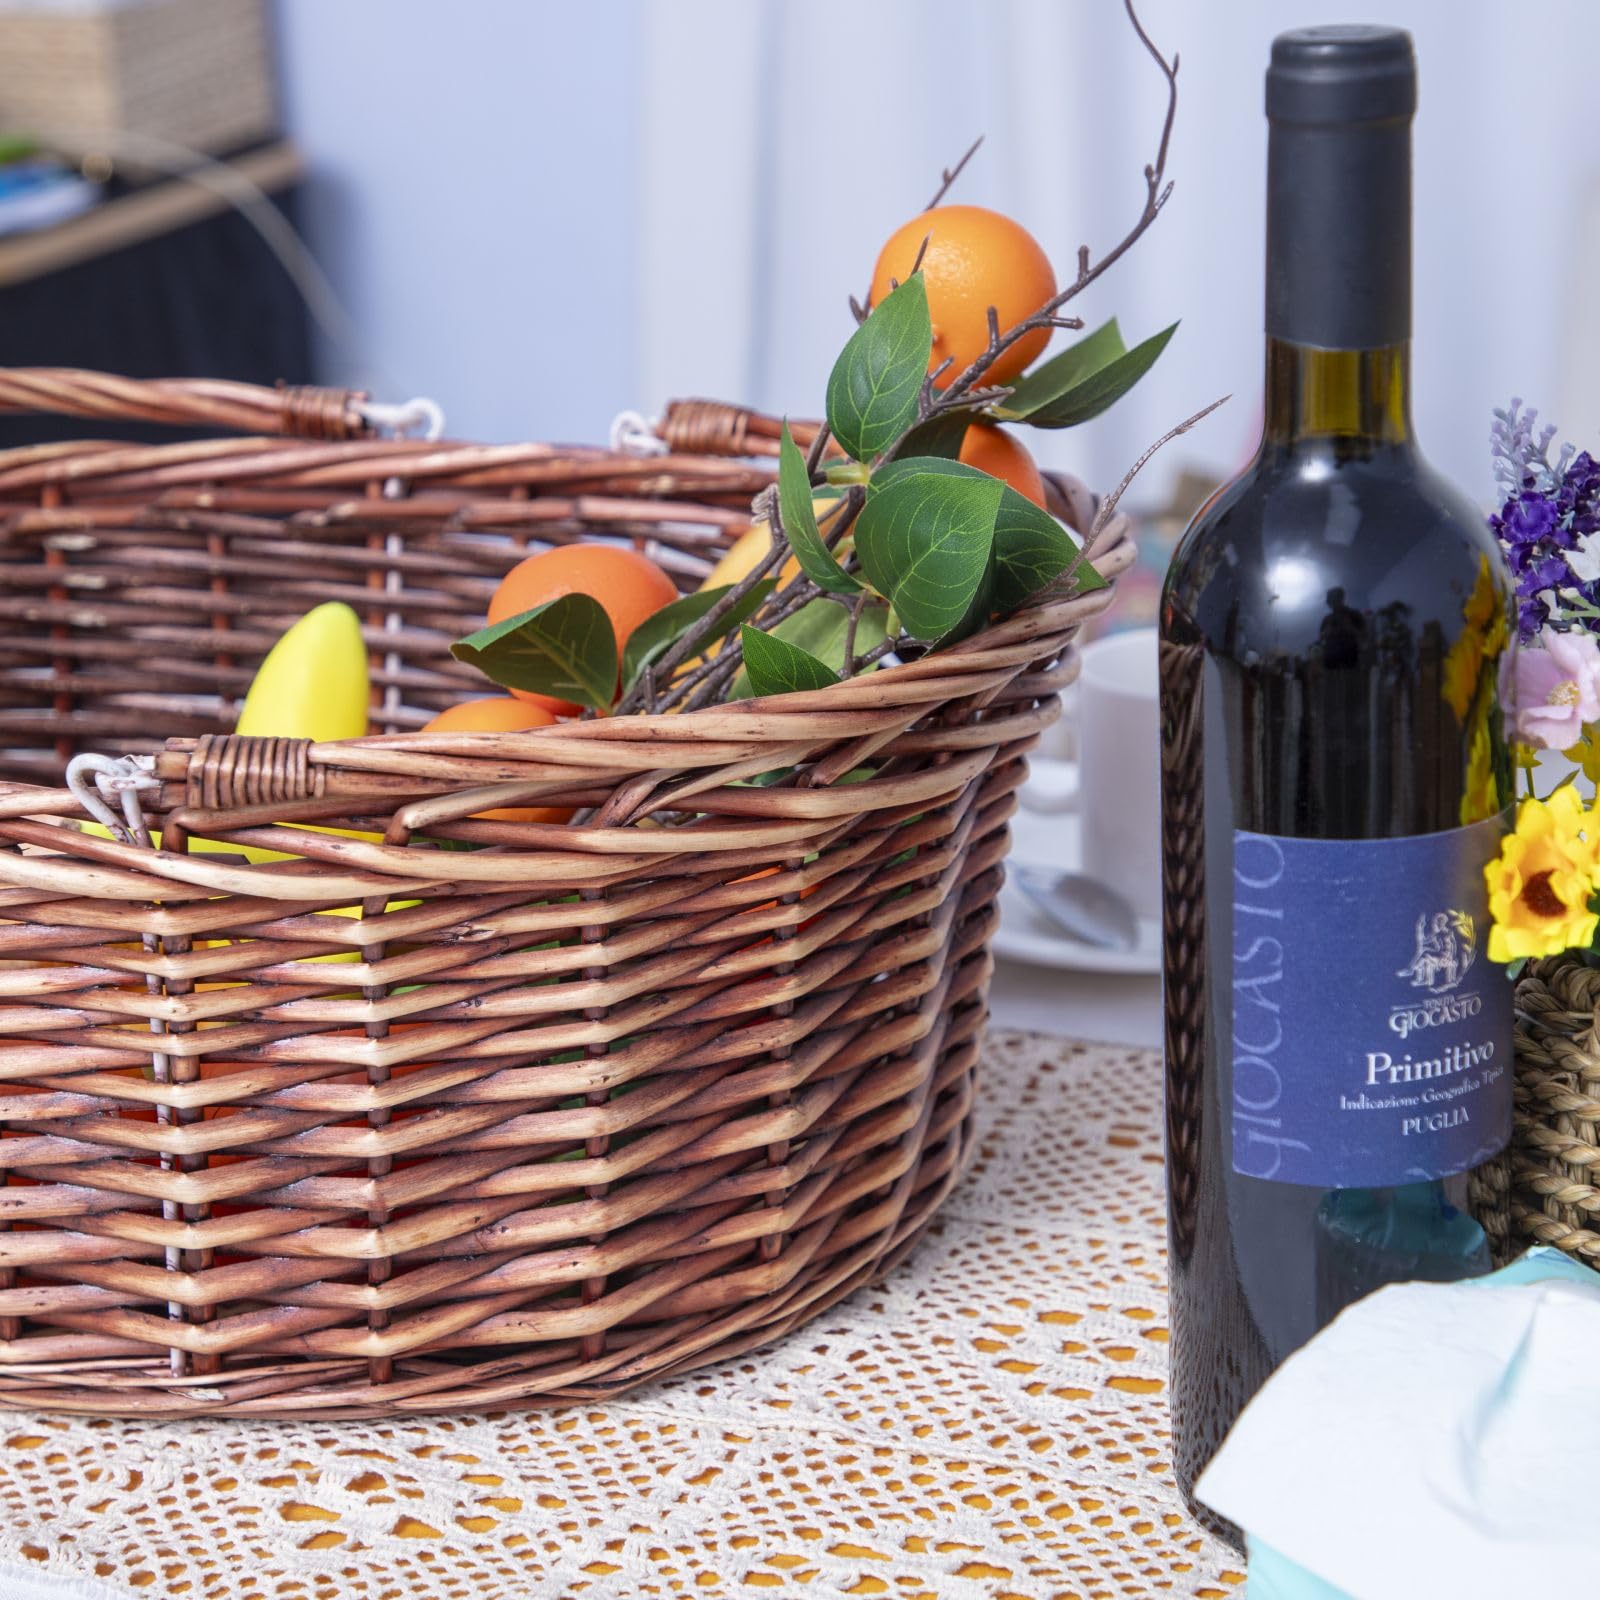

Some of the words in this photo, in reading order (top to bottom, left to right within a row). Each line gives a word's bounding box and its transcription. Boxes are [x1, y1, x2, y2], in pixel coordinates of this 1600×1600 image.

[1389, 996, 1482, 1039] GIOCASTO
[1366, 1041, 1495, 1086] Primitivo
[1340, 1093, 1420, 1111] Indicazione
[1402, 1105, 1470, 1136] PUGLIA
